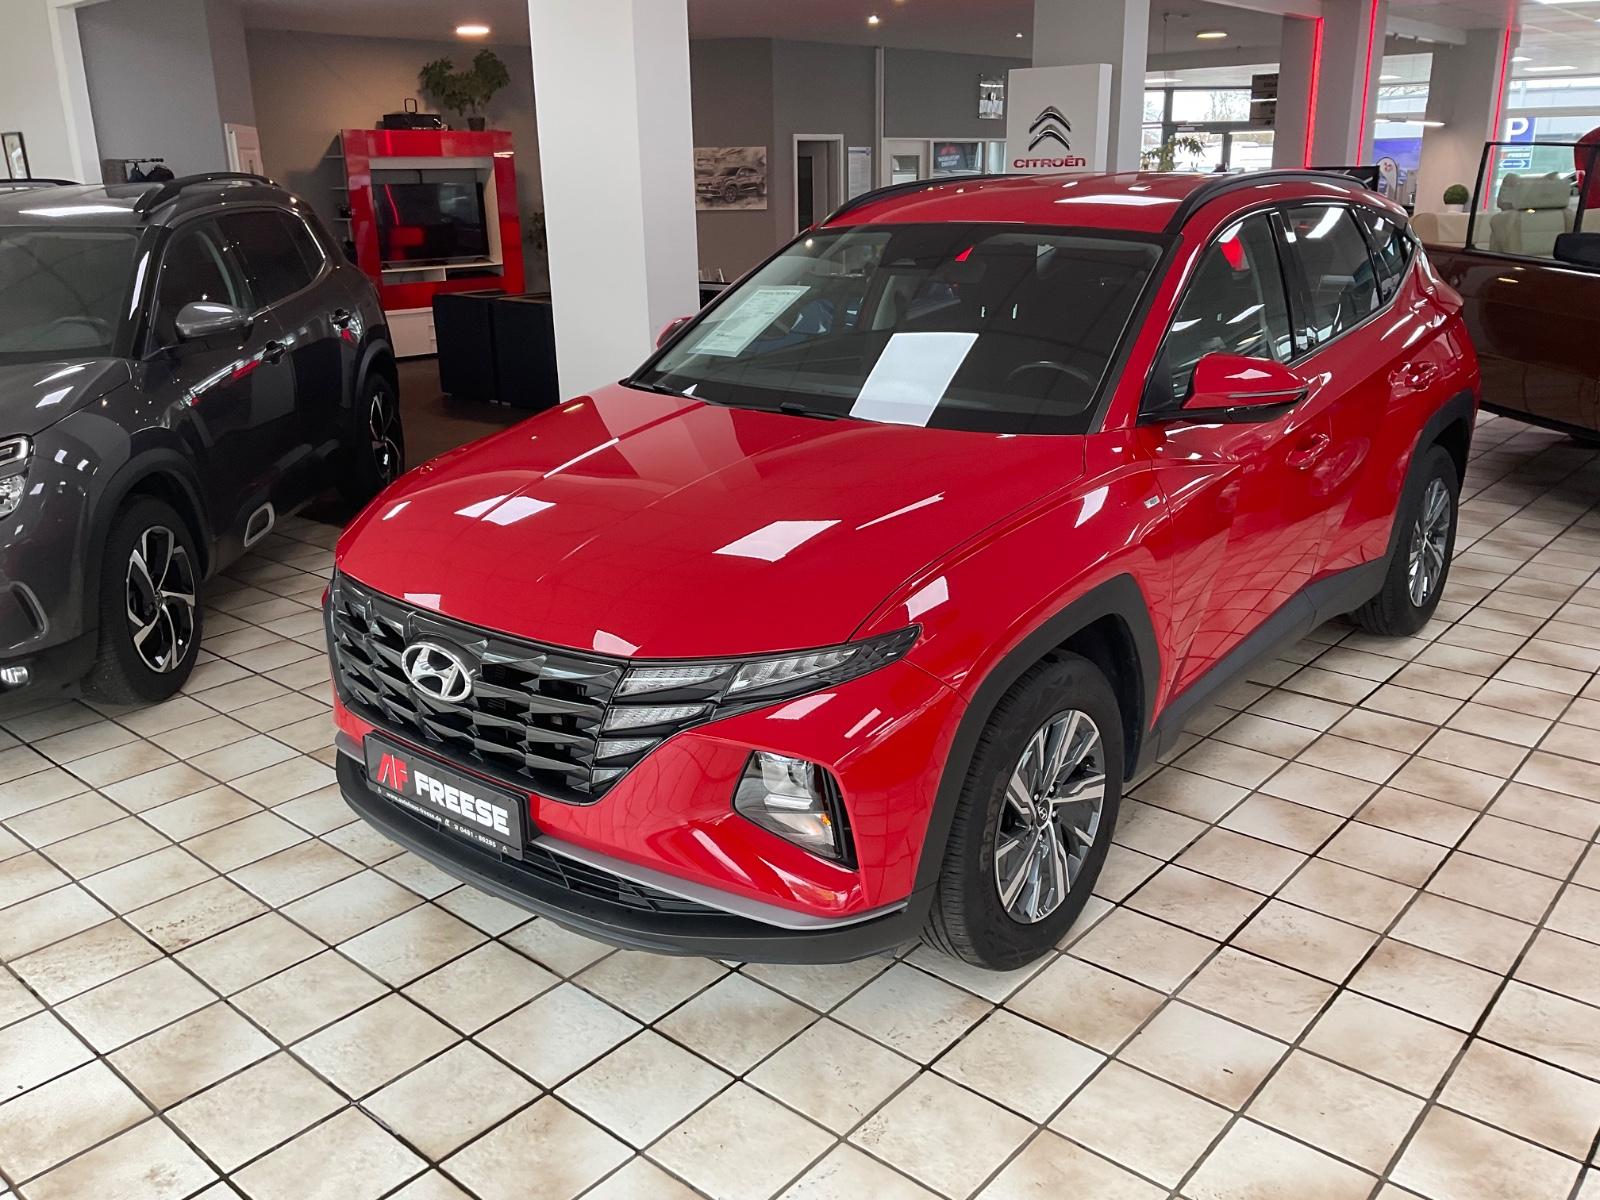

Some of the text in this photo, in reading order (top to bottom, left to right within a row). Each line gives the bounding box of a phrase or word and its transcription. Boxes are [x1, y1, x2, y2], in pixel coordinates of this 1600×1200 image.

[1504, 117, 1529, 143] P
[1013, 155, 1086, 168] CITROËN
[414, 770, 510, 836] FREESE
